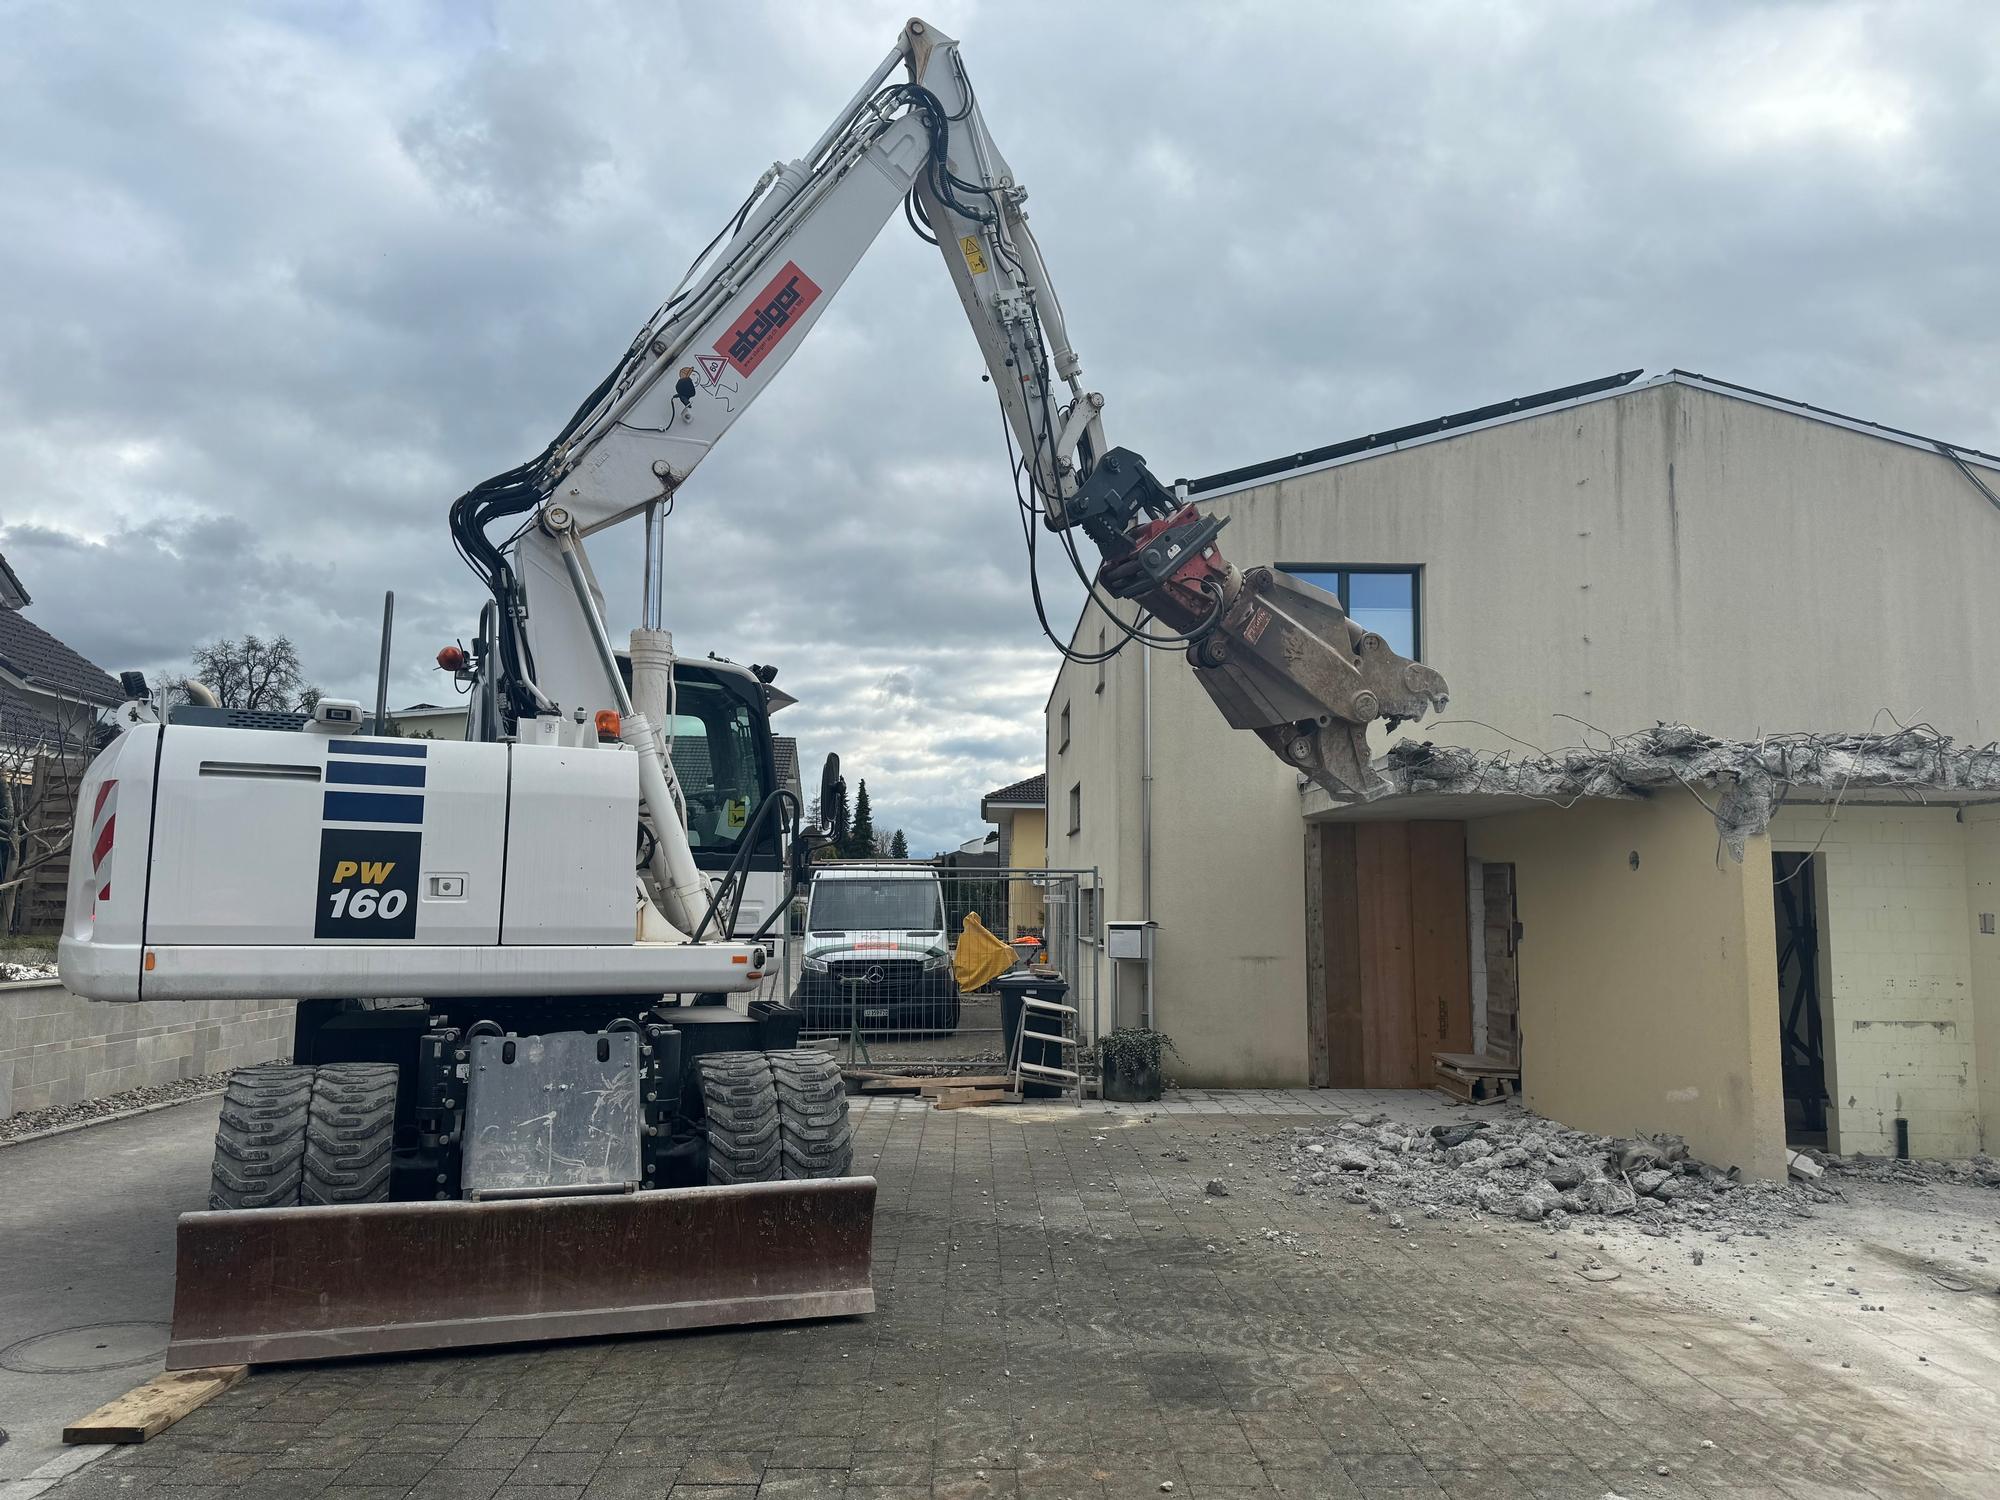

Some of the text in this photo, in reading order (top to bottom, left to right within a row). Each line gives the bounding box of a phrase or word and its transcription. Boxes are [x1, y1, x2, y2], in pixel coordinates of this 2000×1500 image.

[728, 276, 800, 363] steiger
[332, 861, 396, 885] PW
[329, 888, 408, 919] 160
